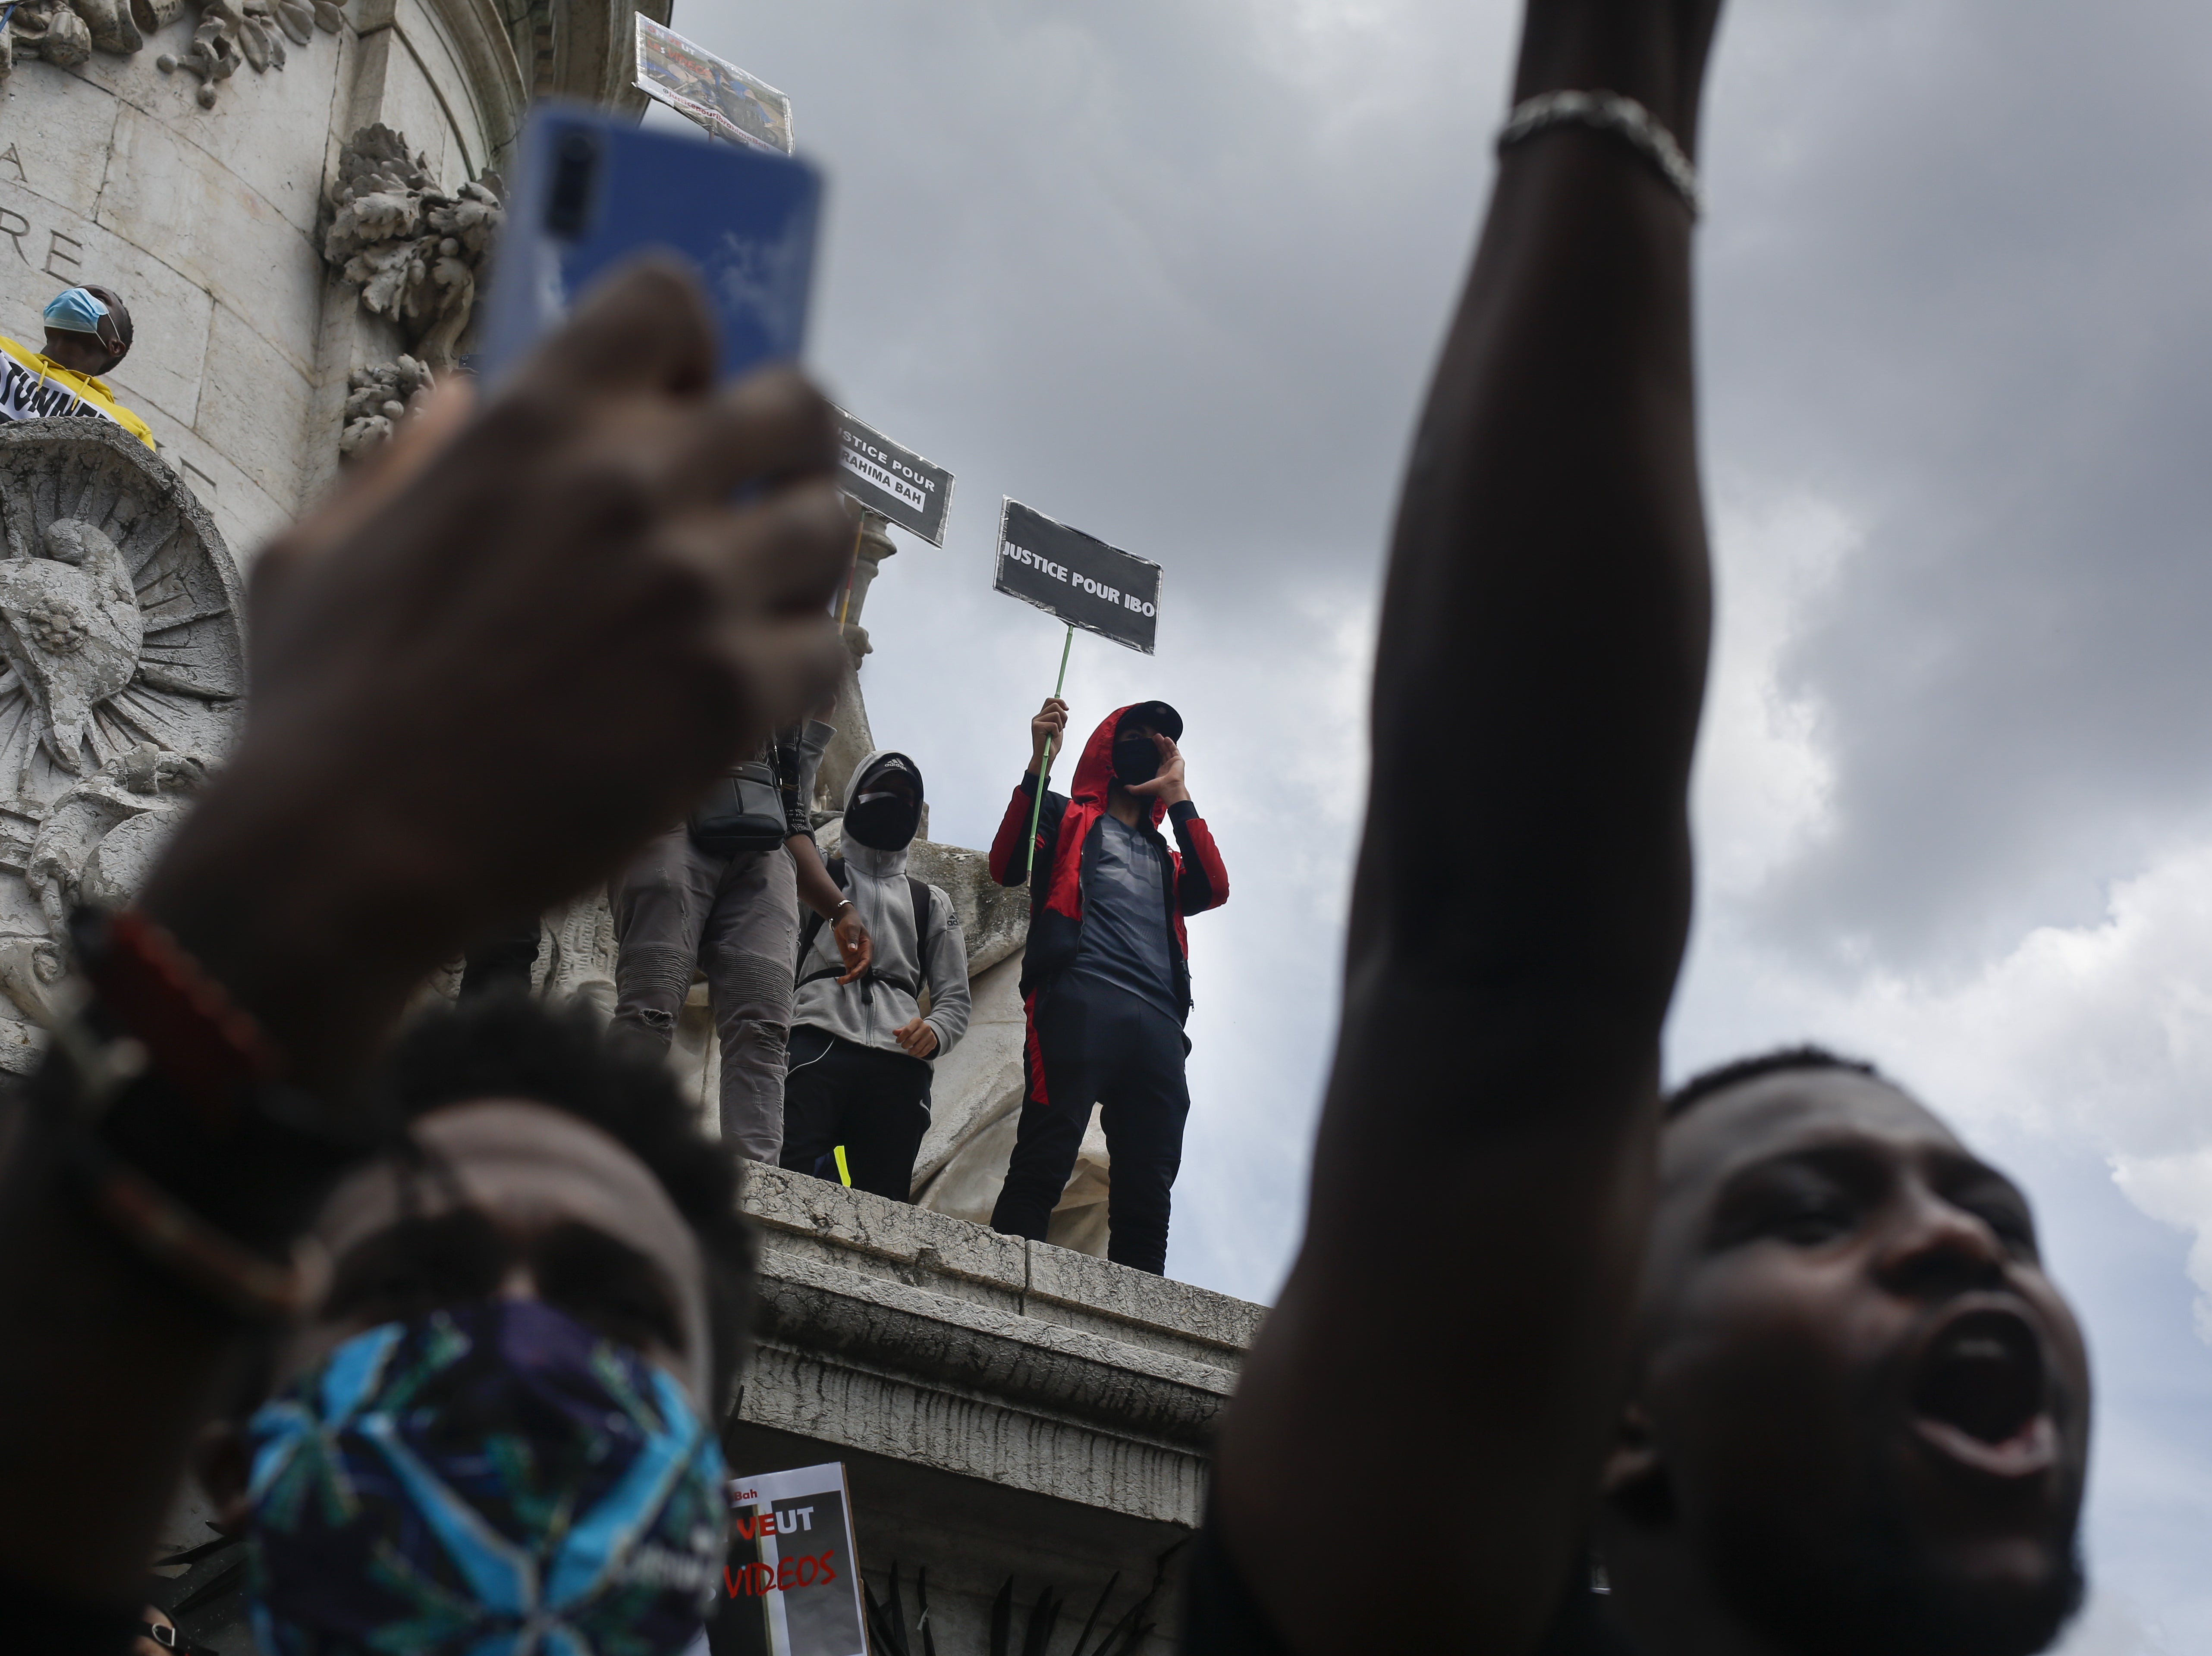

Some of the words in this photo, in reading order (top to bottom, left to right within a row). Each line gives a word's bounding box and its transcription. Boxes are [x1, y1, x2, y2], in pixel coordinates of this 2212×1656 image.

[648, 25, 664, 39] ON
[667, 35, 695, 55] VEUT
[667, 47, 711, 79] VIDEOS
[892, 459, 936, 492] POUR
[895, 482, 921, 505] BAH
[1002, 540, 1068, 583] JUSTICE
[1071, 572, 1120, 605] POUR
[1124, 593, 1155, 618] IBO
[736, 1506, 814, 1540] VEUT
[723, 1549, 837, 1599] VIDEOS
